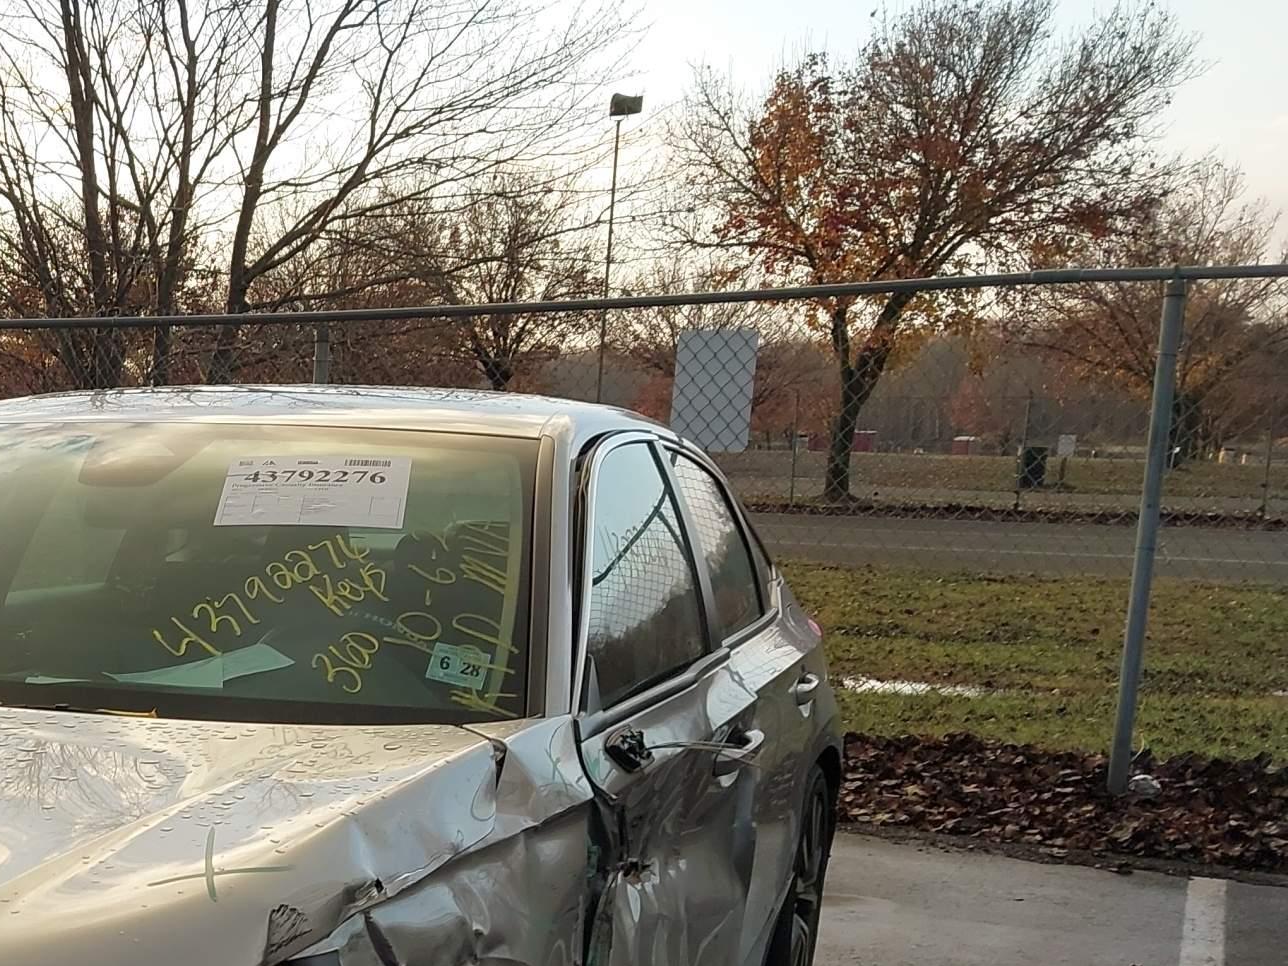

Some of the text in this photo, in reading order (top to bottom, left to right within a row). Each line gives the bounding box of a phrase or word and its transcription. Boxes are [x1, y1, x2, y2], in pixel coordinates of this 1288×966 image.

[244, 468, 387, 485] 43792276
[439, 655, 481, 677] 6 28
